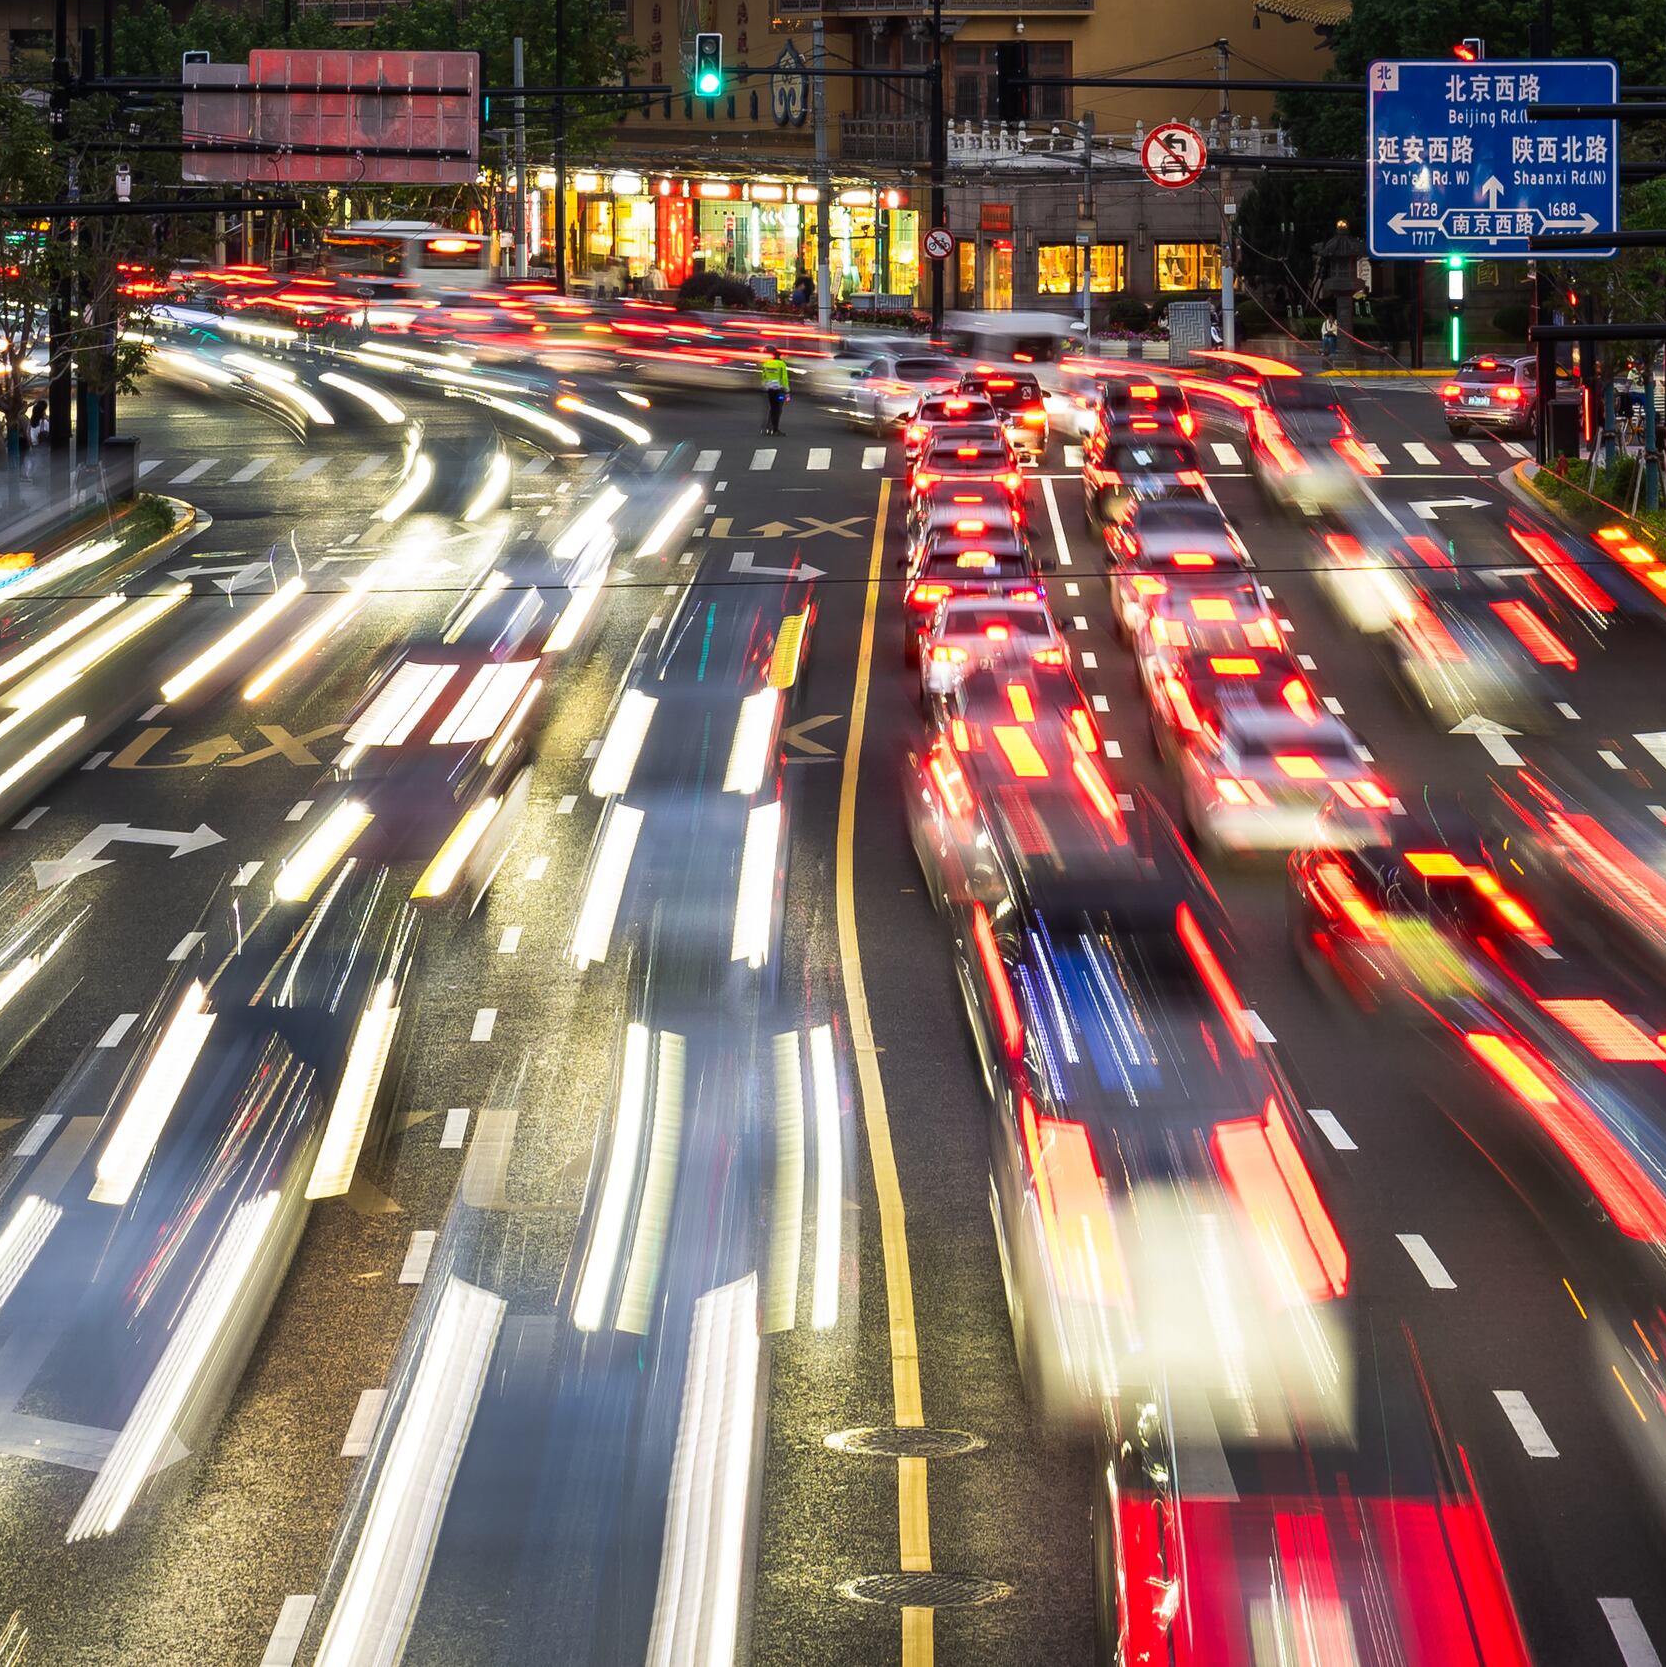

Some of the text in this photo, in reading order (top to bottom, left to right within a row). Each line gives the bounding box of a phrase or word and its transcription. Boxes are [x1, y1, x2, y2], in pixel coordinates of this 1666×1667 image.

[1377, 65, 1392, 80] 北
[1445, 74, 1541, 103] 北京西路
[1448, 109, 1496, 128] Beijing
[1378, 135, 1474, 165] 延安西路
[1512, 135, 1608, 165] 陕西北路
[1382, 170, 1427, 186] Yan'a
[1514, 170, 1607, 186] Shaanxi Rd.(N)
[1410, 203, 1438, 218] 1728
[1548, 202, 1577, 217] 1688
[1452, 213, 1535, 235] 南京西路
[1412, 231, 1436, 246] 1717
